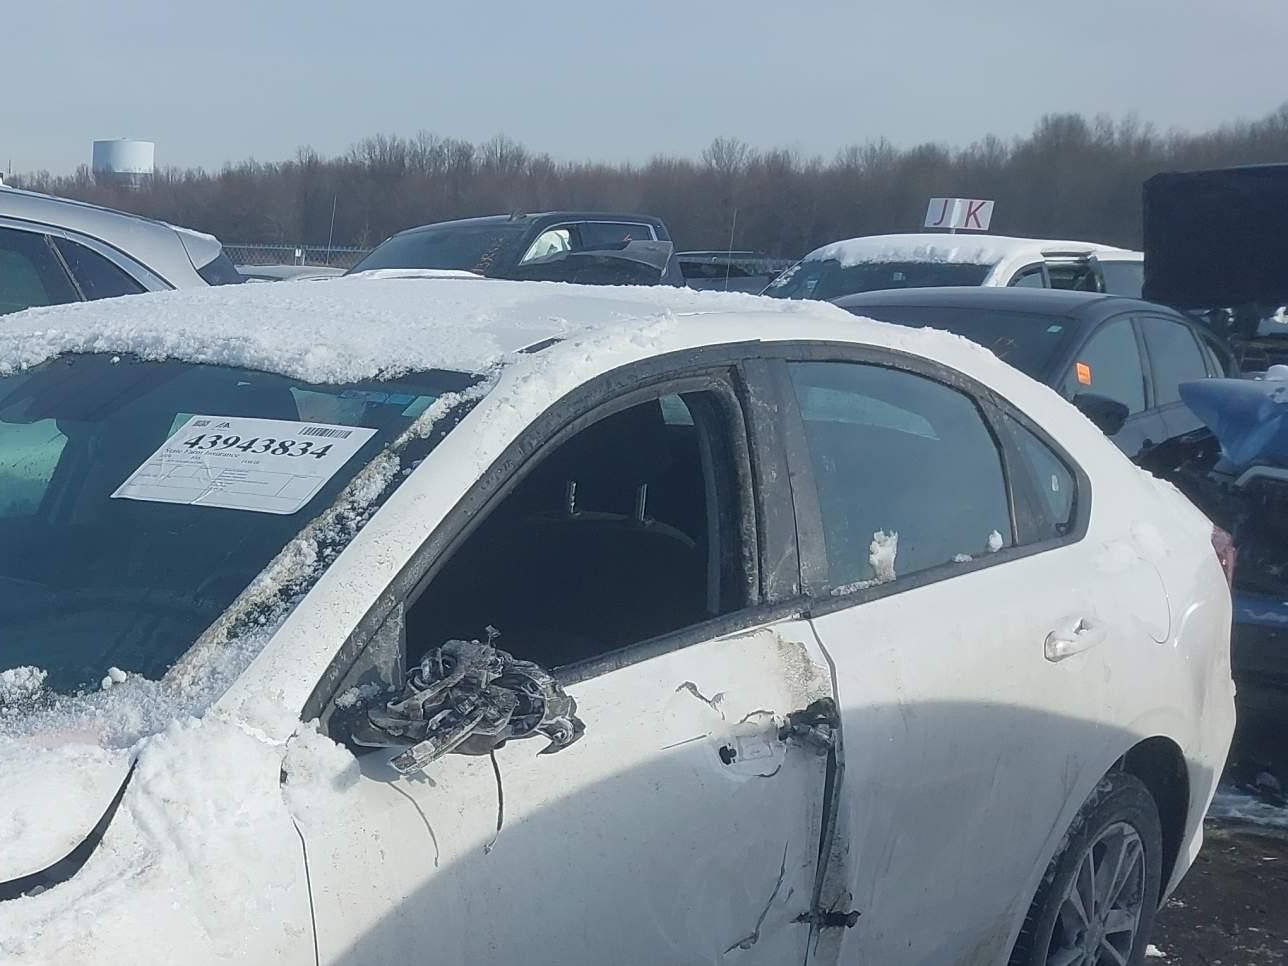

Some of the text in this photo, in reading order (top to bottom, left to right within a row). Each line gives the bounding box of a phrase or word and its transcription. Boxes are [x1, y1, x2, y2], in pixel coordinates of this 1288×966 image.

[933, 200, 985, 228] J K
[183, 433, 334, 460] 43943834
